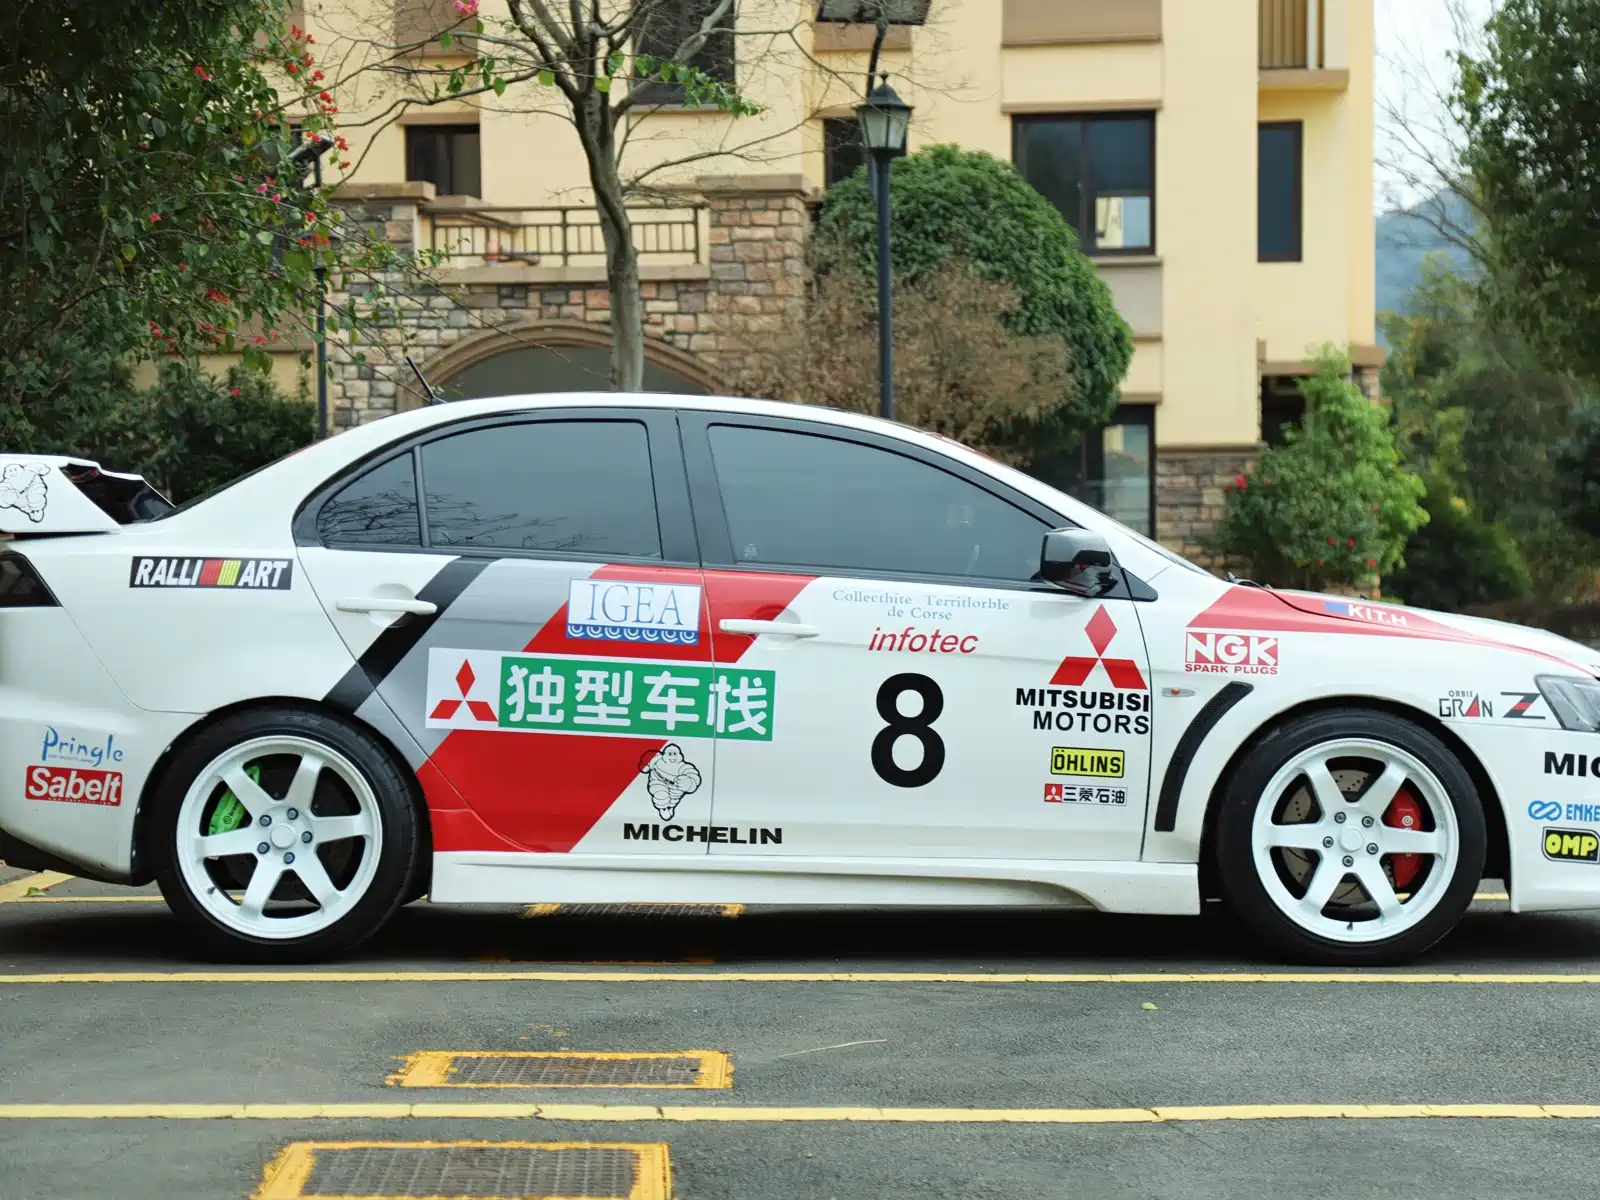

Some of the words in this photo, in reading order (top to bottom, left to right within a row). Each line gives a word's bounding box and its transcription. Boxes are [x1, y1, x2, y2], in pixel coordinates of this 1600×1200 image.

[134, 559, 203, 586] RALLI
[237, 560, 288, 588] ART
[586, 583, 684, 626] IGEA
[887, 606, 904, 618] de
[910, 607, 953, 621] Corse
[868, 626, 979, 654] infotec
[1185, 631, 1279, 667] NGK
[1184, 663, 1229, 674] SPARK
[1234, 665, 1278, 676] PLUGS
[505, 663, 768, 736] 独型车栈
[1015, 687, 1150, 712] MITSUBISI
[1439, 693, 1493, 718] GRAN
[1448, 690, 1474, 698] ORBIS
[871, 672, 946, 788] 8
[1033, 710, 1149, 736] MOTORS
[42, 724, 124, 768] Pringle
[1054, 749, 1122, 774] ÖHLINS
[28, 767, 121, 803] Sabelt
[1063, 786, 1126, 804] 三菱石油
[623, 822, 784, 846] MICHELIN
[1545, 833, 1598, 857] OMP
